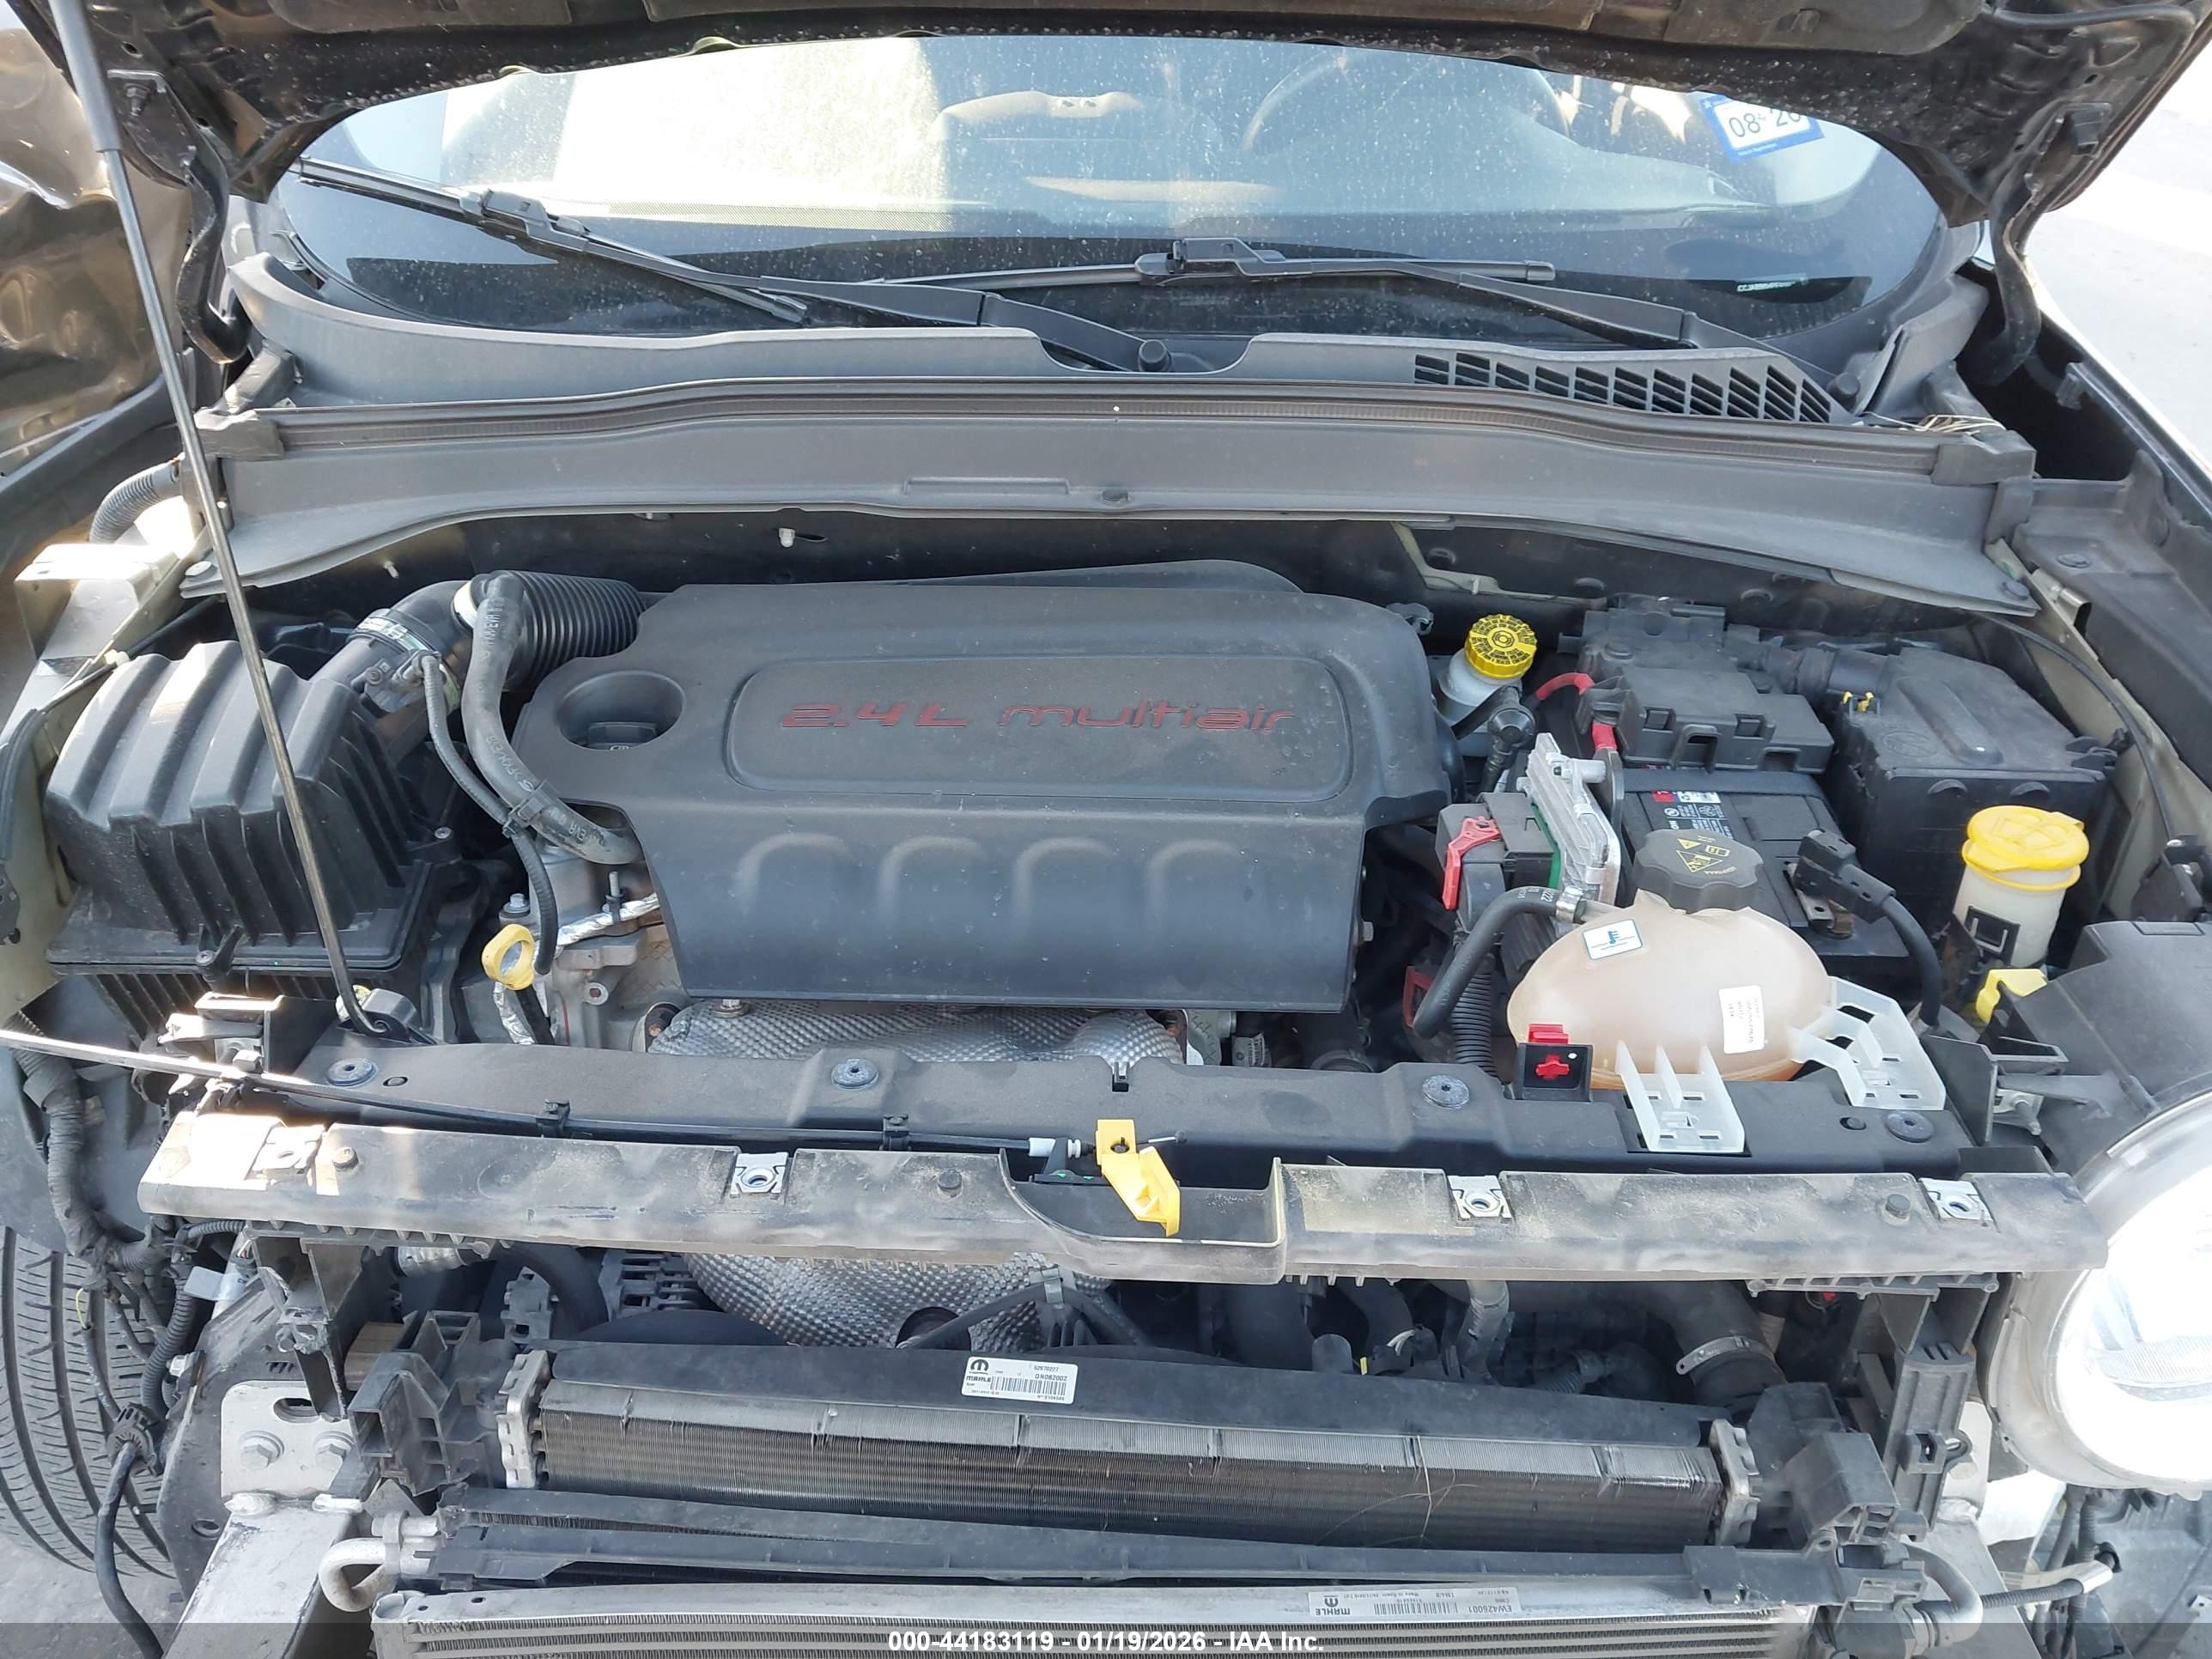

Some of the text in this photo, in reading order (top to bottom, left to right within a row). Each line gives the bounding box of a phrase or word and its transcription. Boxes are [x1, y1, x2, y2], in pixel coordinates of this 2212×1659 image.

[1729, 112, 1761, 137] 08
[998, 701, 1295, 731] multiair
[1468, 1605, 1512, 1613] EW426001
